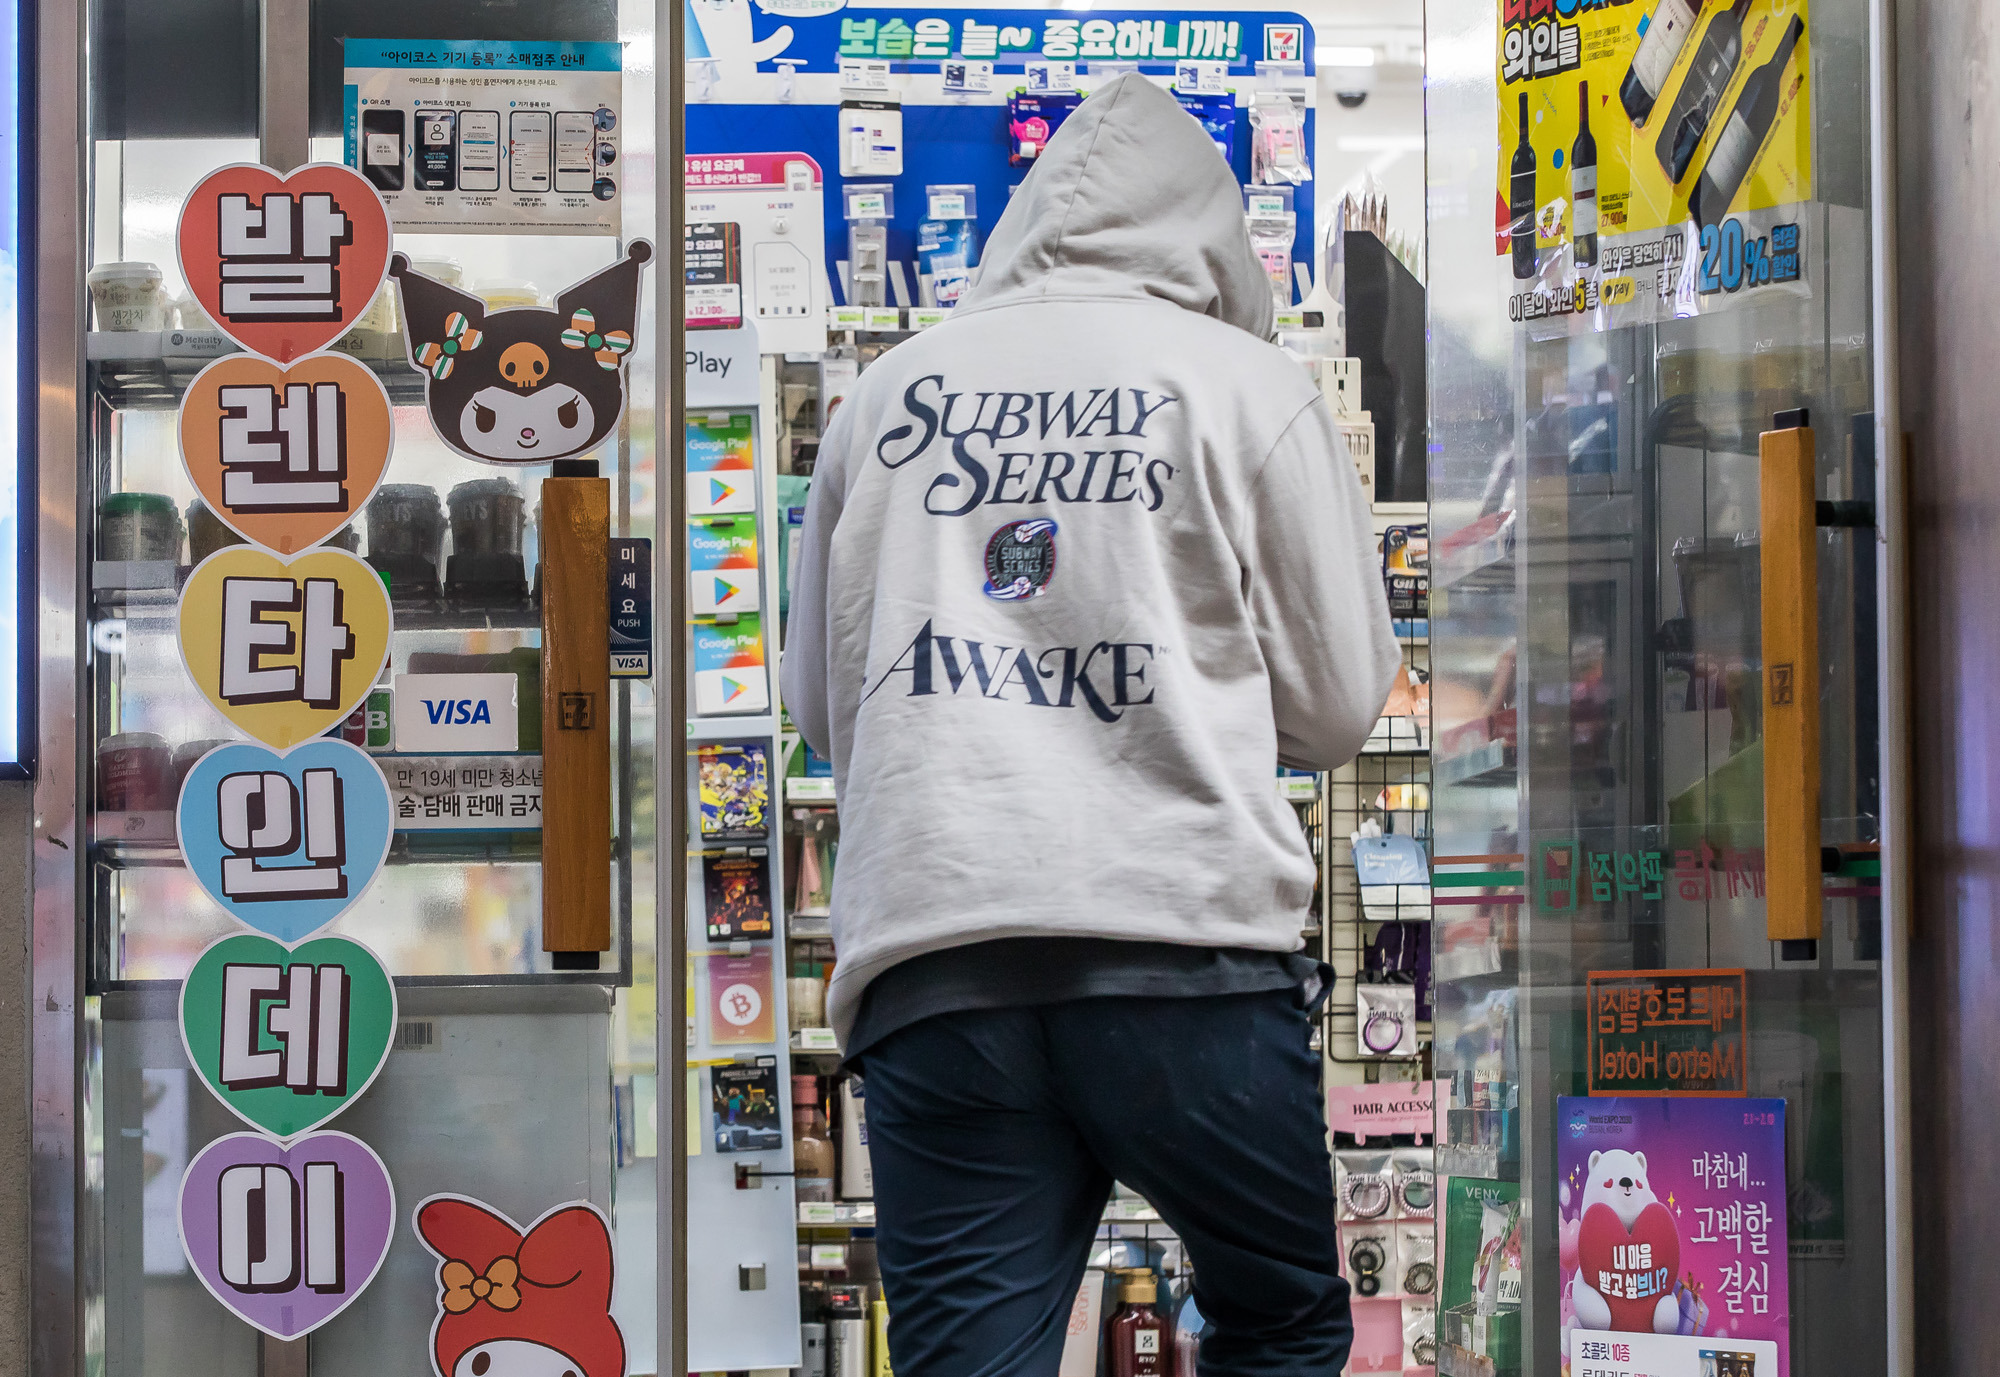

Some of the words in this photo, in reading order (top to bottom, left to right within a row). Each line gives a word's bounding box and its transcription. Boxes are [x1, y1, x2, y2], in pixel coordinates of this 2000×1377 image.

[839, 18, 950, 57] 보습은
[1041, 19, 1240, 58] 중요하니까!
[443, 52, 467, 65] 기기
[507, 54, 556, 66] 소매점주
[561, 54, 586, 66] 안내
[1503, 22, 1580, 80] 와인들
[408, 77, 441, 85] 아이코스를
[442, 77, 468, 86] 사용하는
[469, 77, 483, 86] 성인
[1602, 246, 1632, 274] 와인은
[1633, 240, 1665, 268] 당연히
[1700, 217, 1771, 295] 20%
[1772, 224, 1799, 251] 현장
[1772, 253, 1799, 280] 할인
[1550, 287, 1574, 316] 와인
[111, 308, 145, 325] 생강차
[185, 336, 223, 347] McNulty
[685, 351, 732, 379] Play
[877, 375, 1178, 469] SUBWAY
[688, 438, 726, 452] Google
[727, 437, 749, 450] Play
[924, 428, 1175, 517] SERIES
[693, 537, 730, 551] Google
[732, 536, 753, 549] Play
[1001, 547, 1043, 560] SUBWAY
[1003, 560, 1042, 573] SERIES
[617, 618, 641, 628] PUSH
[699, 636, 737, 651] Google
[737, 634, 758, 647] Play
[615, 657, 644, 669] VISA
[859, 617, 1155, 723] AWAKE
[343, 709, 388, 730] CB
[420, 699, 491, 725] VISA
[397, 769, 414, 789] 만
[420, 768, 456, 788] 19세
[462, 768, 494, 788] 미만
[466, 794, 504, 818] 판매
[1369, 1010, 1388, 1018] HAIR
[1389, 1010, 1405, 1018] TIES
[1353, 1102, 1384, 1115] HAIR
[1604, 1115, 1619, 1124] EXPO
[1690, 1199, 1773, 1255] 고백할
[1613, 1243, 1626, 1271] 내
[1628, 1243, 1652, 1270] 마음
[1598, 1269, 1623, 1298] 받고
[1717, 1260, 1769, 1315] 결심
[1581, 1341, 1610, 1361] 초콜릿
[1611, 1343, 1630, 1362] 10종
